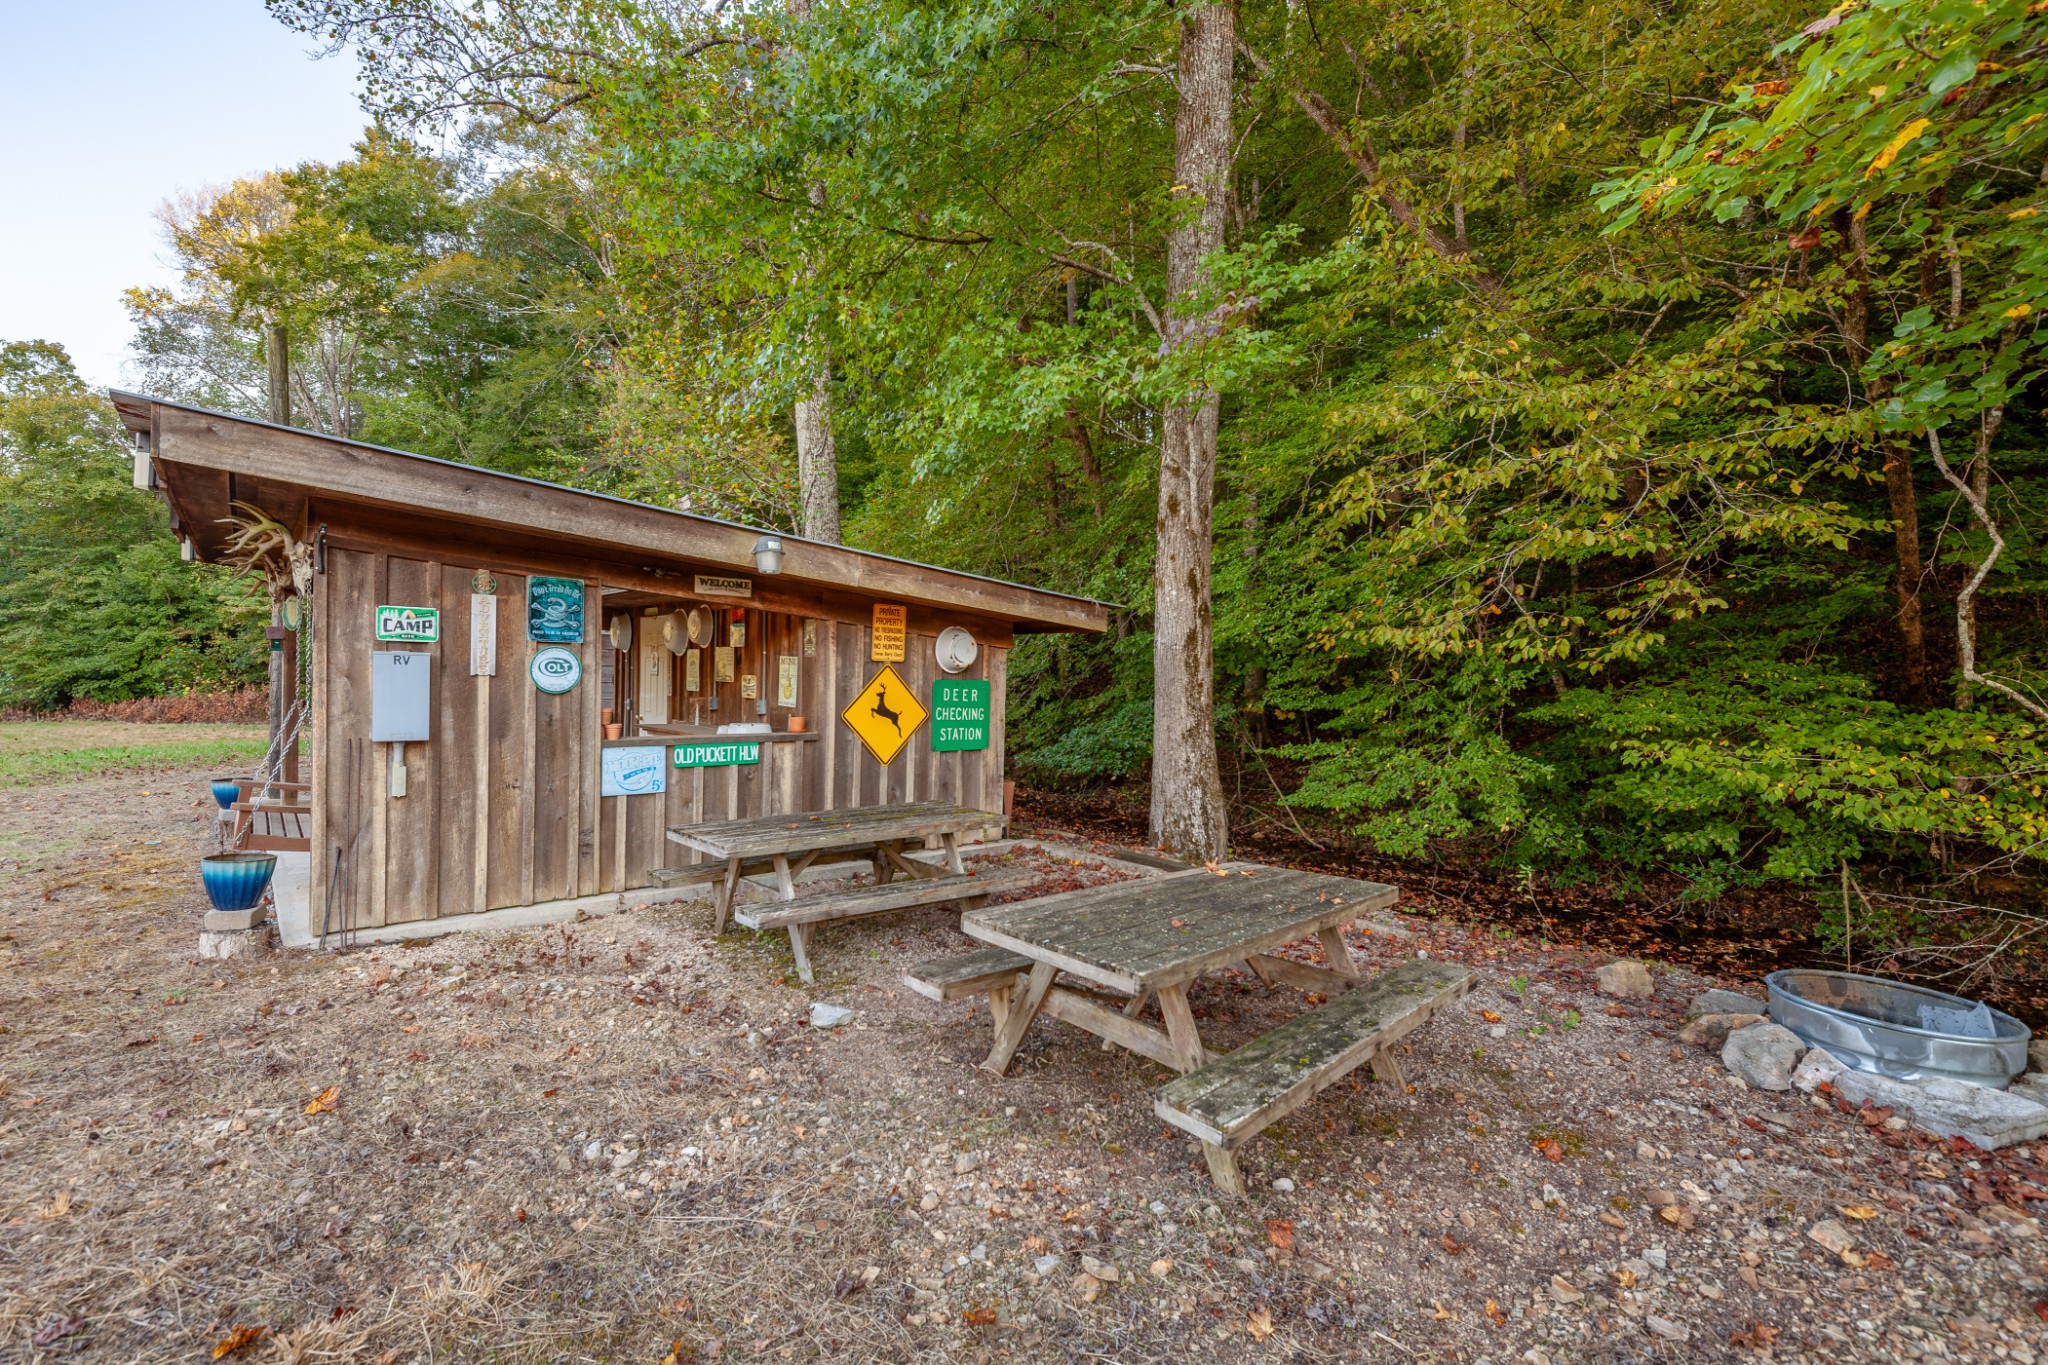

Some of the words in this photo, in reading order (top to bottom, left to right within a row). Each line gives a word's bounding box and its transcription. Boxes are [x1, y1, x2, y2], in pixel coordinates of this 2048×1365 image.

[699, 577, 750, 590] WELCOME
[532, 585, 548, 596] Don't
[879, 607, 901, 617] PRIVATE
[383, 617, 433, 633] CAMP
[875, 617, 903, 626] PROPERTY
[881, 626, 903, 634] TRESPASSING
[884, 635, 903, 643] FISHING
[874, 642, 881, 650] NO
[393, 655, 410, 665] RV
[539, 658, 573, 677] COLT
[943, 688, 978, 702] DEER
[935, 707, 985, 720] CHECKING
[940, 727, 982, 741] STATION
[674, 748, 694, 764] OLD
[695, 745, 737, 763] PUCKETT
[739, 744, 759, 761] HLW
